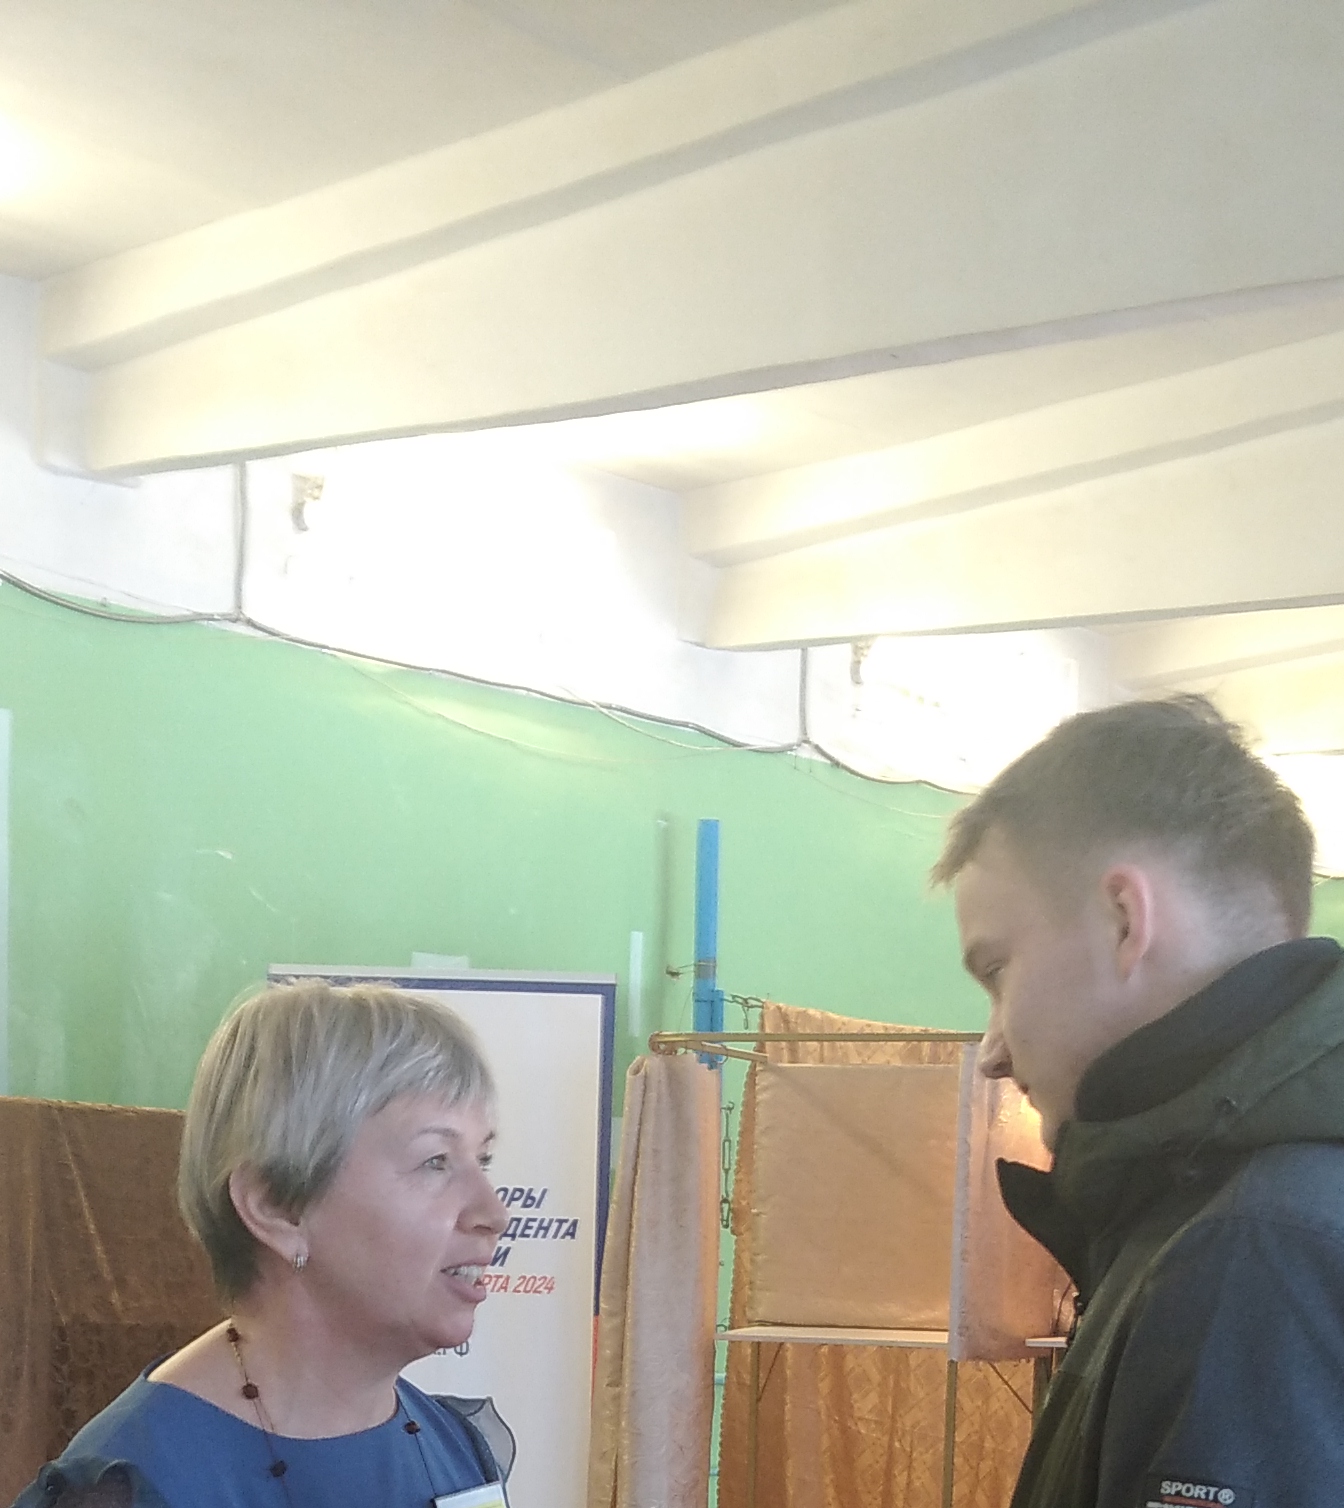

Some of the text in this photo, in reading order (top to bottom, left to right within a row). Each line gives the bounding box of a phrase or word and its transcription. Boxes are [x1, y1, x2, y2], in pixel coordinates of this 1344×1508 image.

[494, 1186, 548, 1210] ОРЫ
[499, 1216, 580, 1241] ДЕНТА
[511, 1274, 556, 1295] 2024
